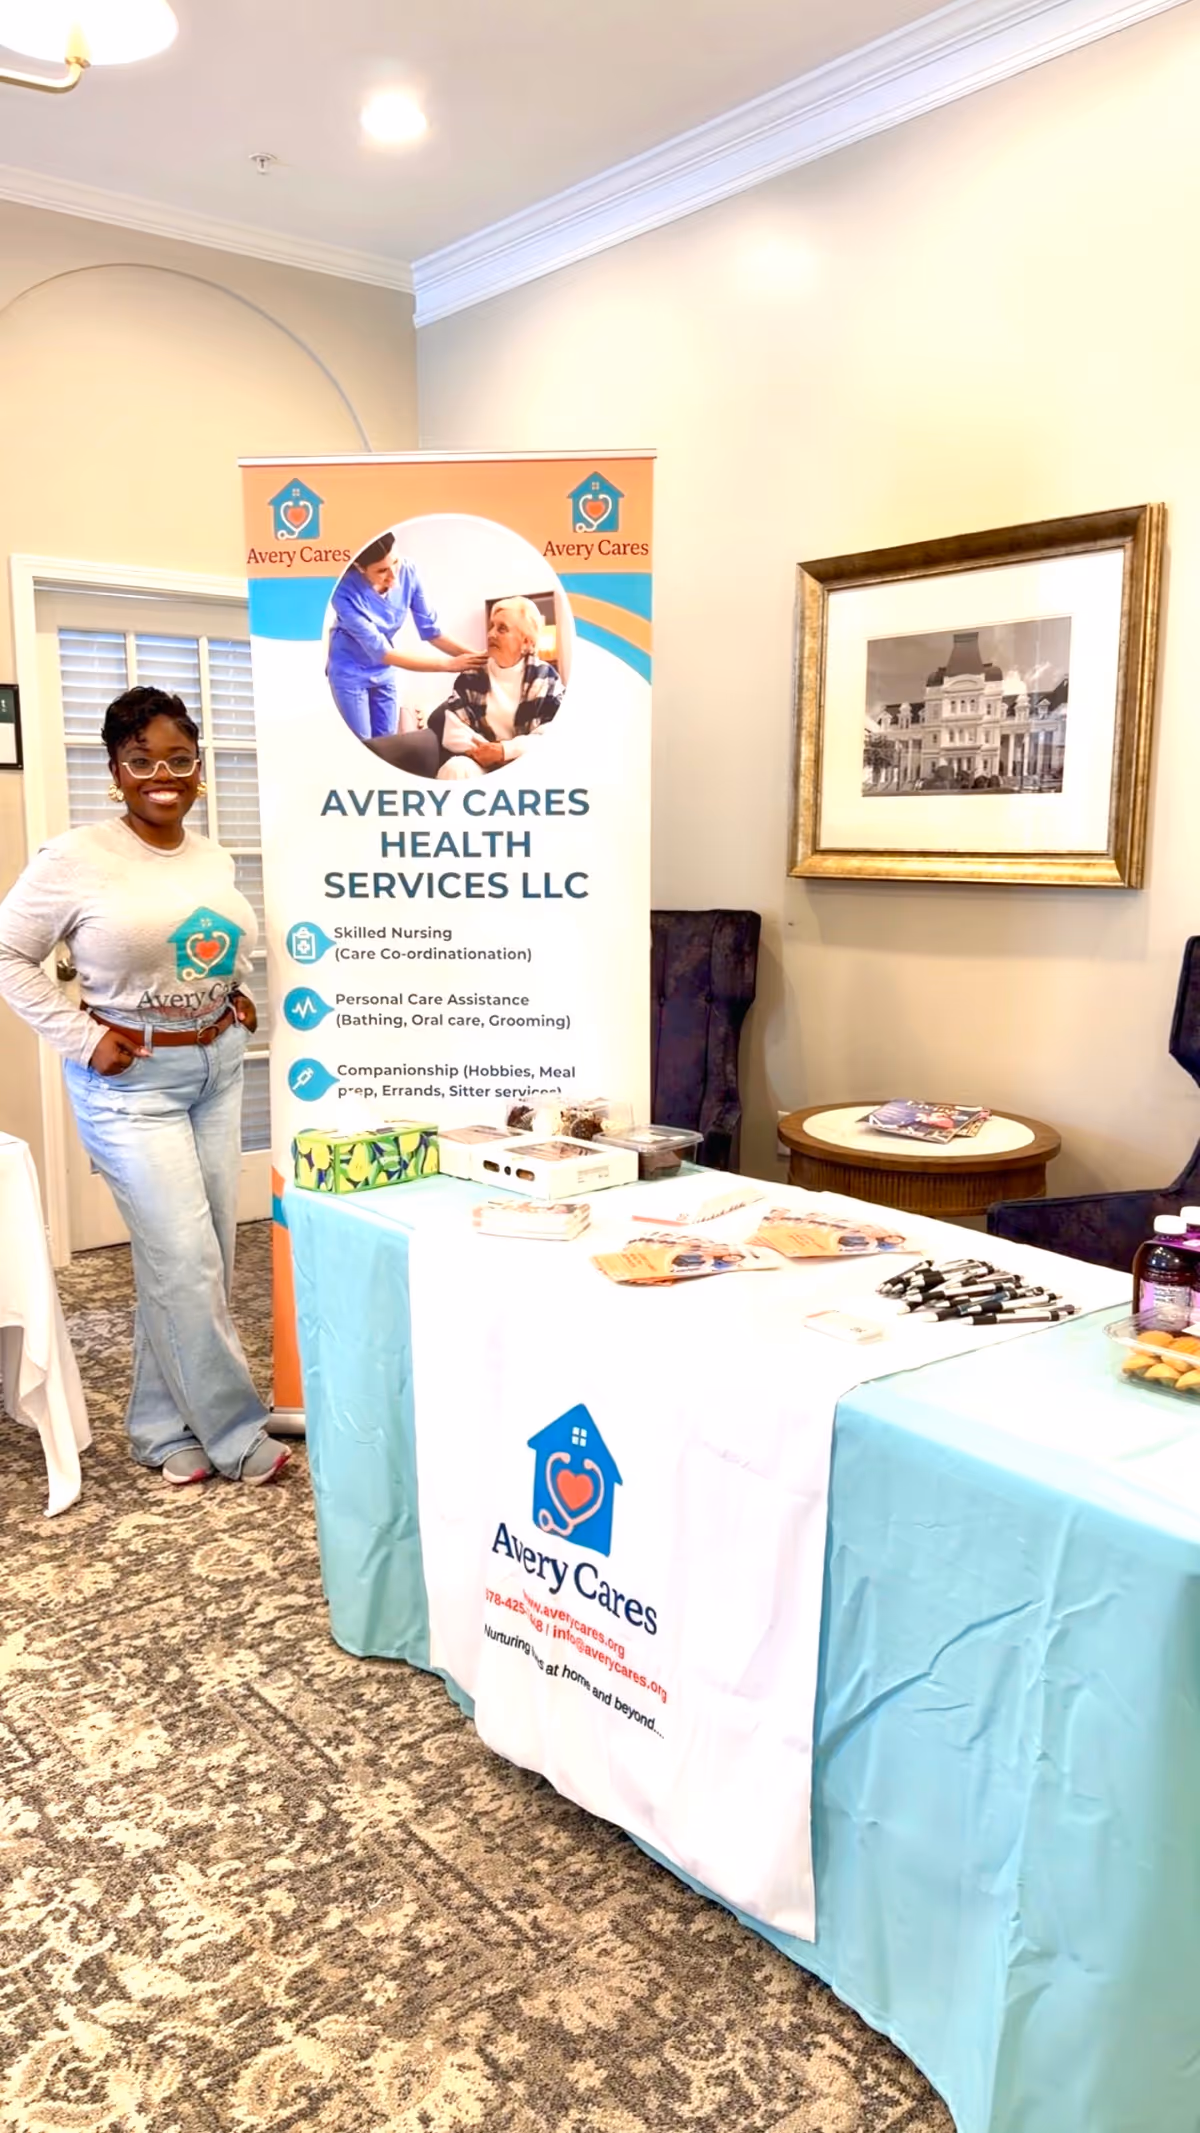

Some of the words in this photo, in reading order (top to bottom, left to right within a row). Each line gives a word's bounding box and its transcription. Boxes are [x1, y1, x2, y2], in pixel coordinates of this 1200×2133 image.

[247, 548, 297, 567] Avery
[300, 546, 351, 563] Cares
[543, 540, 595, 560] Avery
[598, 539, 649, 556] Cares
[321, 790, 451, 816] AVERY
[463, 788, 589, 816] CARES
[381, 831, 530, 858] HEALTH
[325, 872, 508, 898] SERVICES
[523, 872, 588, 898] LLC
[334, 927, 386, 939] Skilled
[392, 926, 452, 941] Nursing
[335, 948, 375, 962] (Care
[381, 947, 531, 963] Co-ordinationation)
[137, 991, 205, 1011] Avery
[336, 993, 402, 1005] Personal
[408, 994, 443, 1005] Care
[447, 993, 529, 1005] Assistance
[337, 1013, 407, 1028] (Bathing,
[412, 1014, 442, 1025] Oral
[448, 1017, 484, 1028] care,
[489, 1015, 570, 1029] Grooming)
[337, 1064, 459, 1079] Companionship
[464, 1065, 534, 1079] (Hobbies,
[540, 1066, 575, 1078] Meal
[383, 1085, 444, 1098] Errands,
[449, 1085, 490, 1097] Sitter
[492, 1523, 569, 1594] Avery
[574, 1563, 657, 1635] Cares
[523, 1589, 625, 1660] w.averycares.org
[484, 1624, 531, 1656] Nurturing
[546, 1665, 560, 1676] at
[562, 1665, 591, 1691] home
[592, 1687, 612, 1705] and
